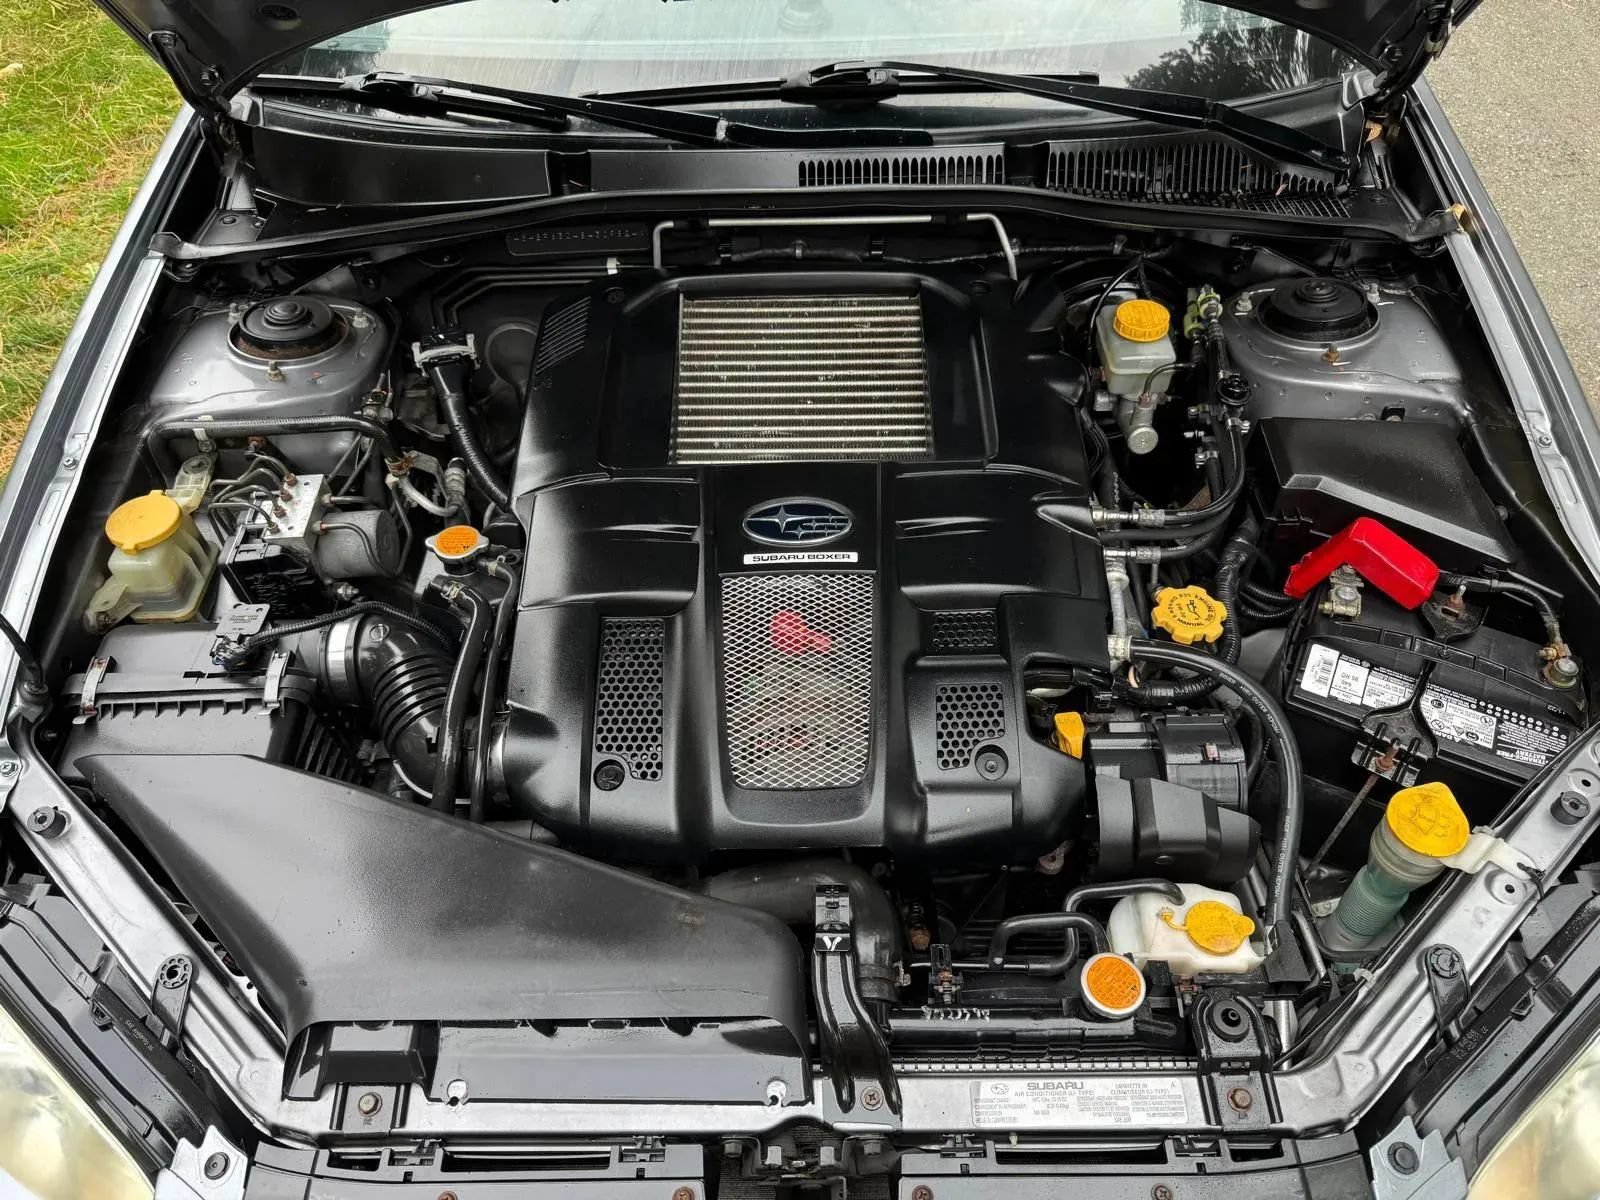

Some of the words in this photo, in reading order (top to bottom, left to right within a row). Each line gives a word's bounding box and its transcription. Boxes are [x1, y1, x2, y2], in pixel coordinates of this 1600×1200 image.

[752, 554, 805, 562] SUBARU
[1516, 749, 1547, 760] BATTERY
[1027, 1081, 1084, 1090] SUBARU
